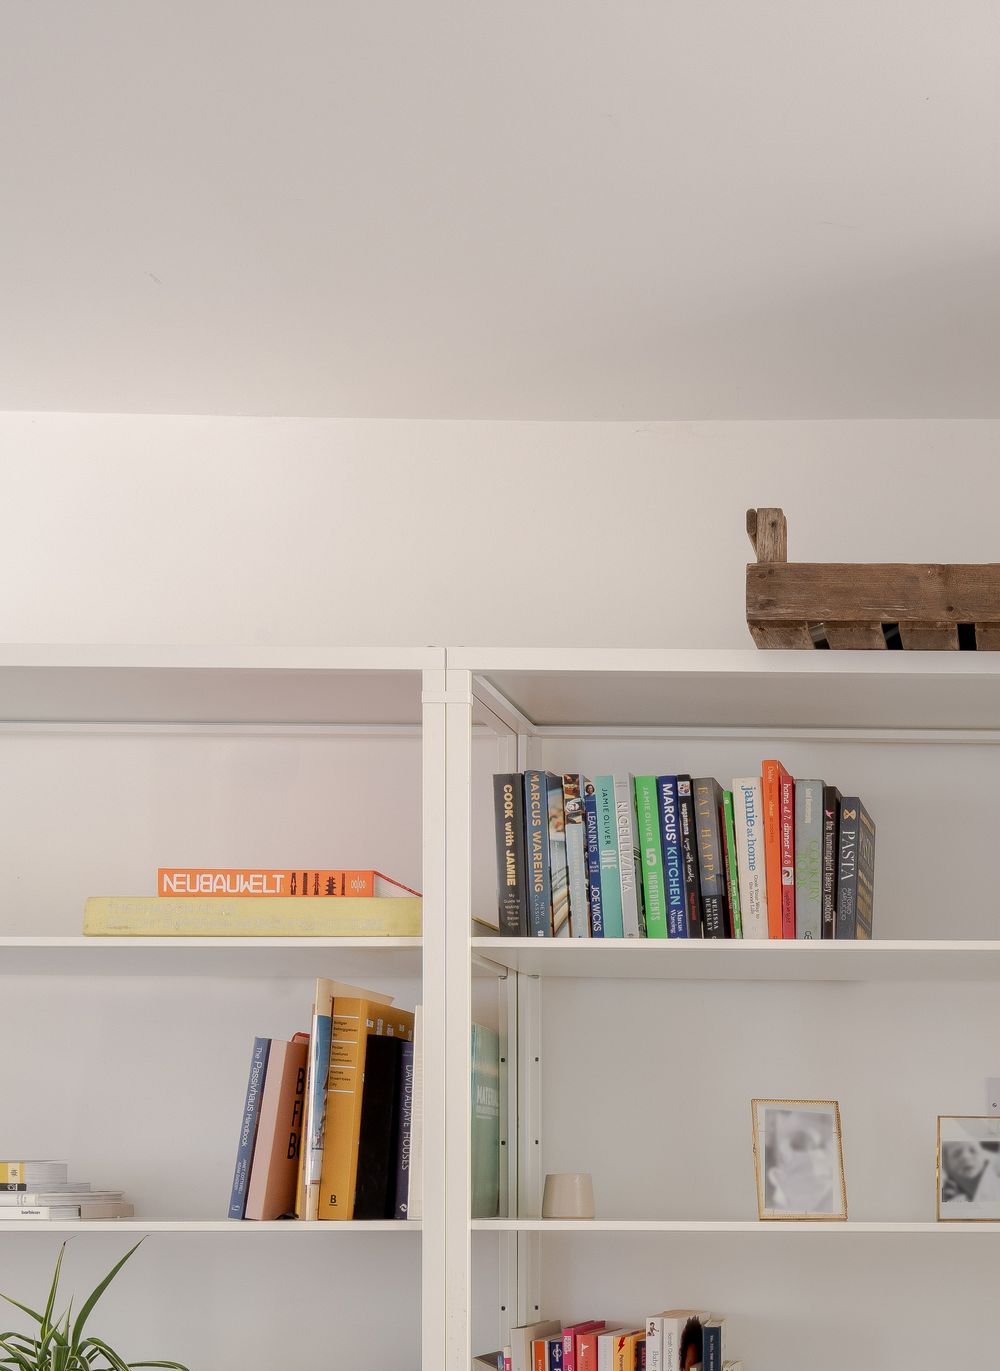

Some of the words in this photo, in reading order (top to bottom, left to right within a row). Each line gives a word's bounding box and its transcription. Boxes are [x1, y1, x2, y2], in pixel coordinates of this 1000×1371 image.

[503, 784, 514, 819] COOK
[530, 772, 541, 826] MARCUS
[601, 788, 610, 813] JAMIE
[642, 786, 651, 811] JAMIE
[697, 786, 710, 817] EAT
[741, 785, 758, 827] jamie
[783, 783, 791, 804] home
[505, 822, 515, 846] with
[587, 811, 597, 833] LEAN
[603, 815, 611, 845] OLIVER
[681, 803, 689, 836] wagamama
[746, 828, 755, 838] at
[826, 820, 834, 831] the
[588, 834, 597, 843] IN
[589, 844, 598, 853] 15
[783, 823, 792, 849] dinner
[532, 830, 544, 893] WAREING
[600, 849, 617, 870] ONE
[646, 847, 657, 866] 5
[701, 828, 715, 882] HAPPY
[747, 839, 758, 871] home
[824, 832, 835, 871] hummingbird
[841, 830, 856, 880] PASTA
[505, 850, 516, 886] JAMIE
[666, 846, 680, 905] KITCHEN
[797, 853, 807, 889] BOOK
[809, 839, 821, 902] COOKERY
[824, 872, 834, 893] bakery
[163, 873, 285, 894] NEUBAUWELT
[591, 885, 600, 903] JOE
[647, 872, 661, 921] INGREDIENTS
[592, 904, 601, 932] WICKS
[676, 910, 684, 932] Marcus
[705, 897, 713, 931] HEMSLEY
[711, 898, 719, 930] MELISSA
[824, 894, 834, 923] cookbook
[254, 1047, 263, 1059] The
[247, 1061, 263, 1112] Passivhaus
[405, 1064, 413, 1093] DAVID
[403, 1094, 411, 1127] ADJAYE
[241, 1113, 253, 1147] Handbook
[401, 1131, 410, 1170] HOUSES
[650, 1350, 659, 1367] Baby
